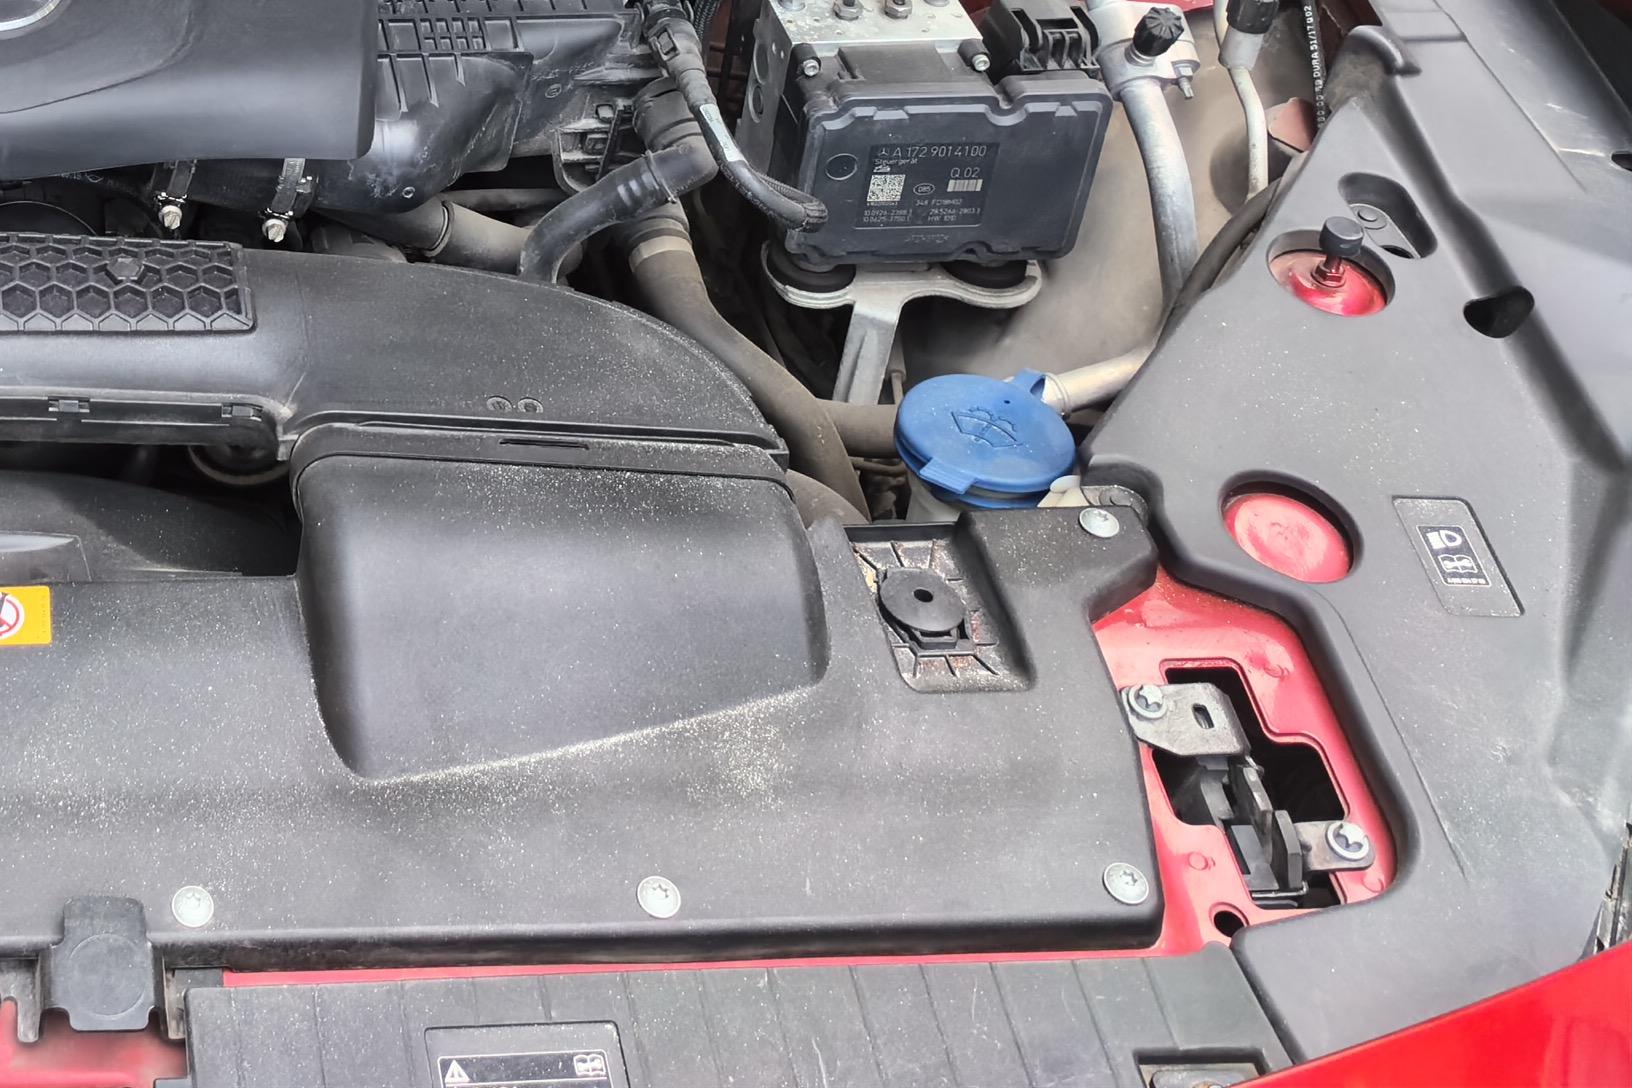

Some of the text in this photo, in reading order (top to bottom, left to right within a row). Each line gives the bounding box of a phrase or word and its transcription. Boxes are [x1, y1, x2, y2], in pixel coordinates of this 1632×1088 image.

[1307, 25, 1318, 50] 51/17
[1311, 51, 1321, 78] DURA
[893, 147, 902, 157] A
